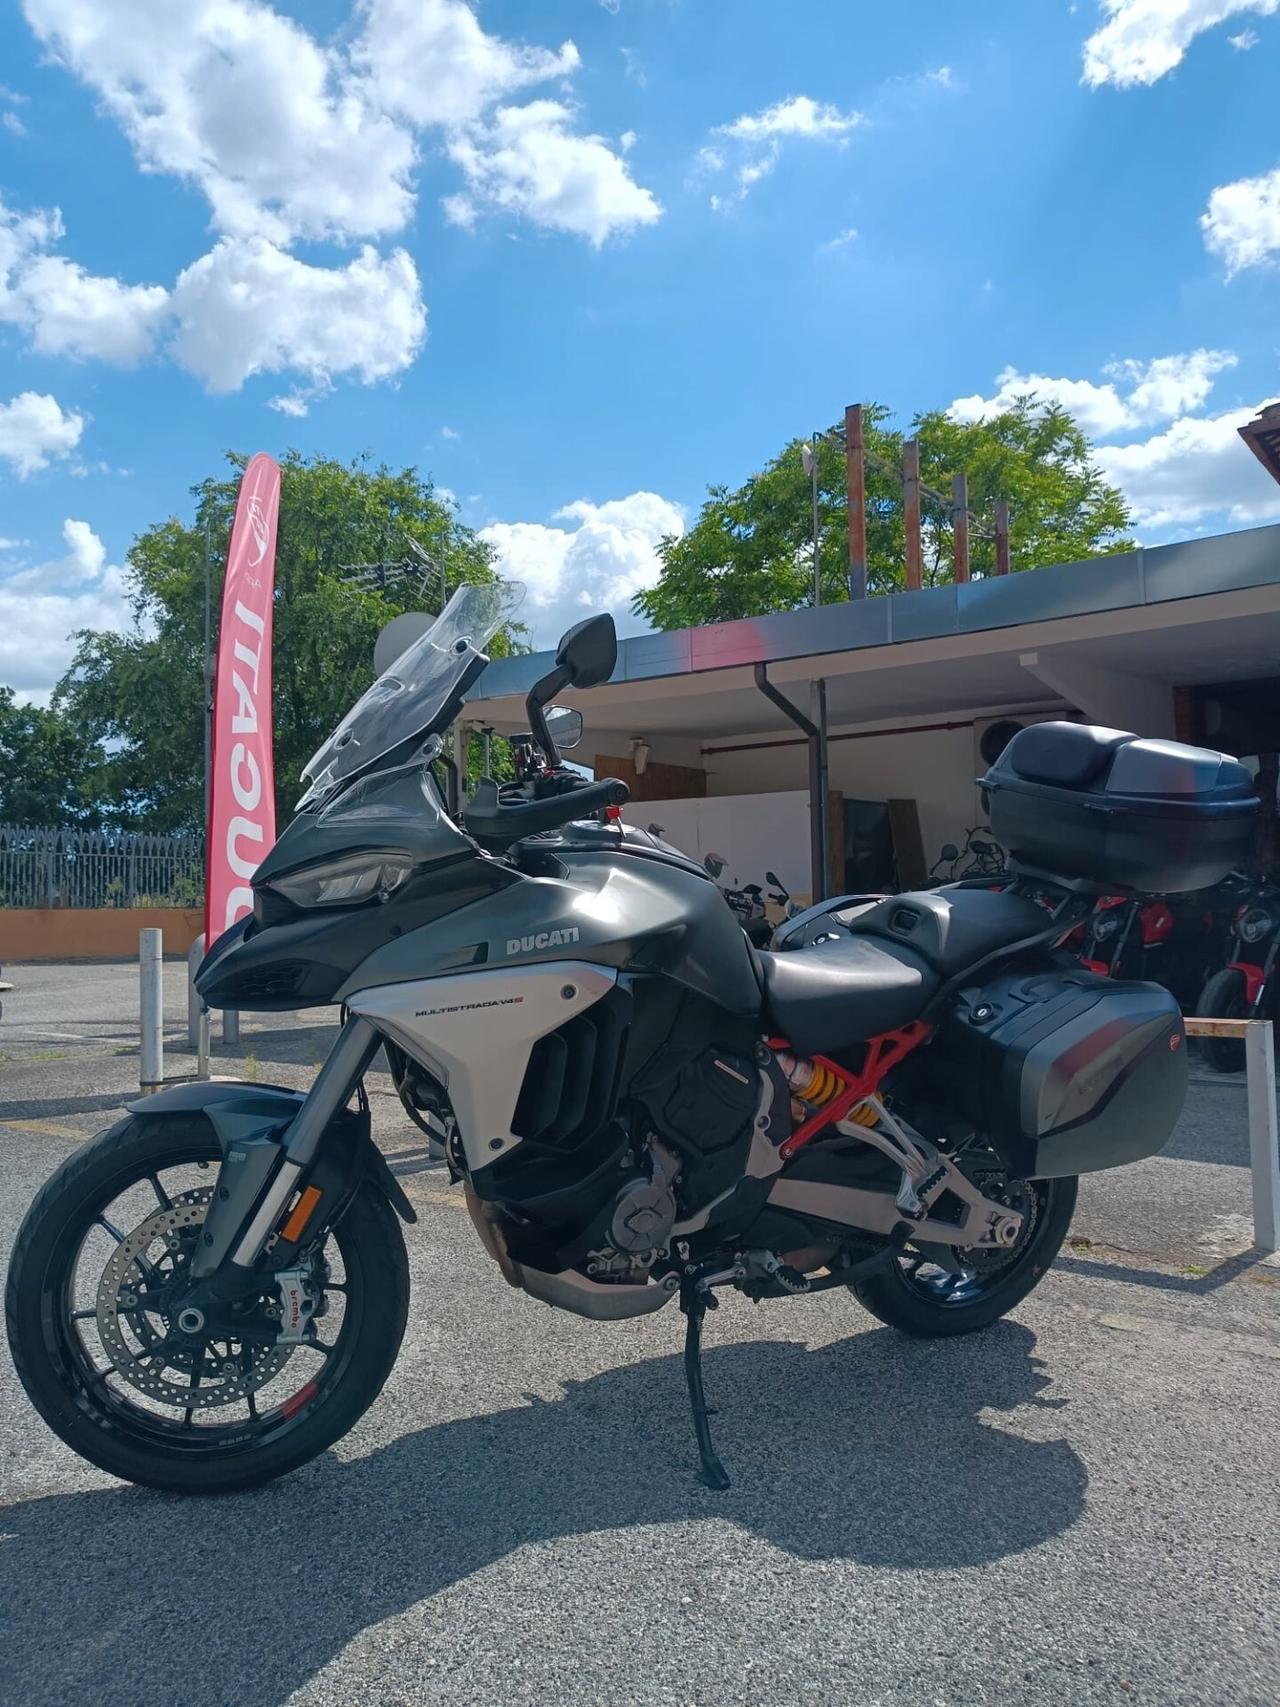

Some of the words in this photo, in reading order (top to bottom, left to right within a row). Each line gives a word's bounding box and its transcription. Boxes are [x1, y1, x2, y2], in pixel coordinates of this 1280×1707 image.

[506, 927, 580, 955] DUCATI
[415, 1001, 499, 1017] MULTISTRADA
[290, 1290, 301, 1328] brembo
